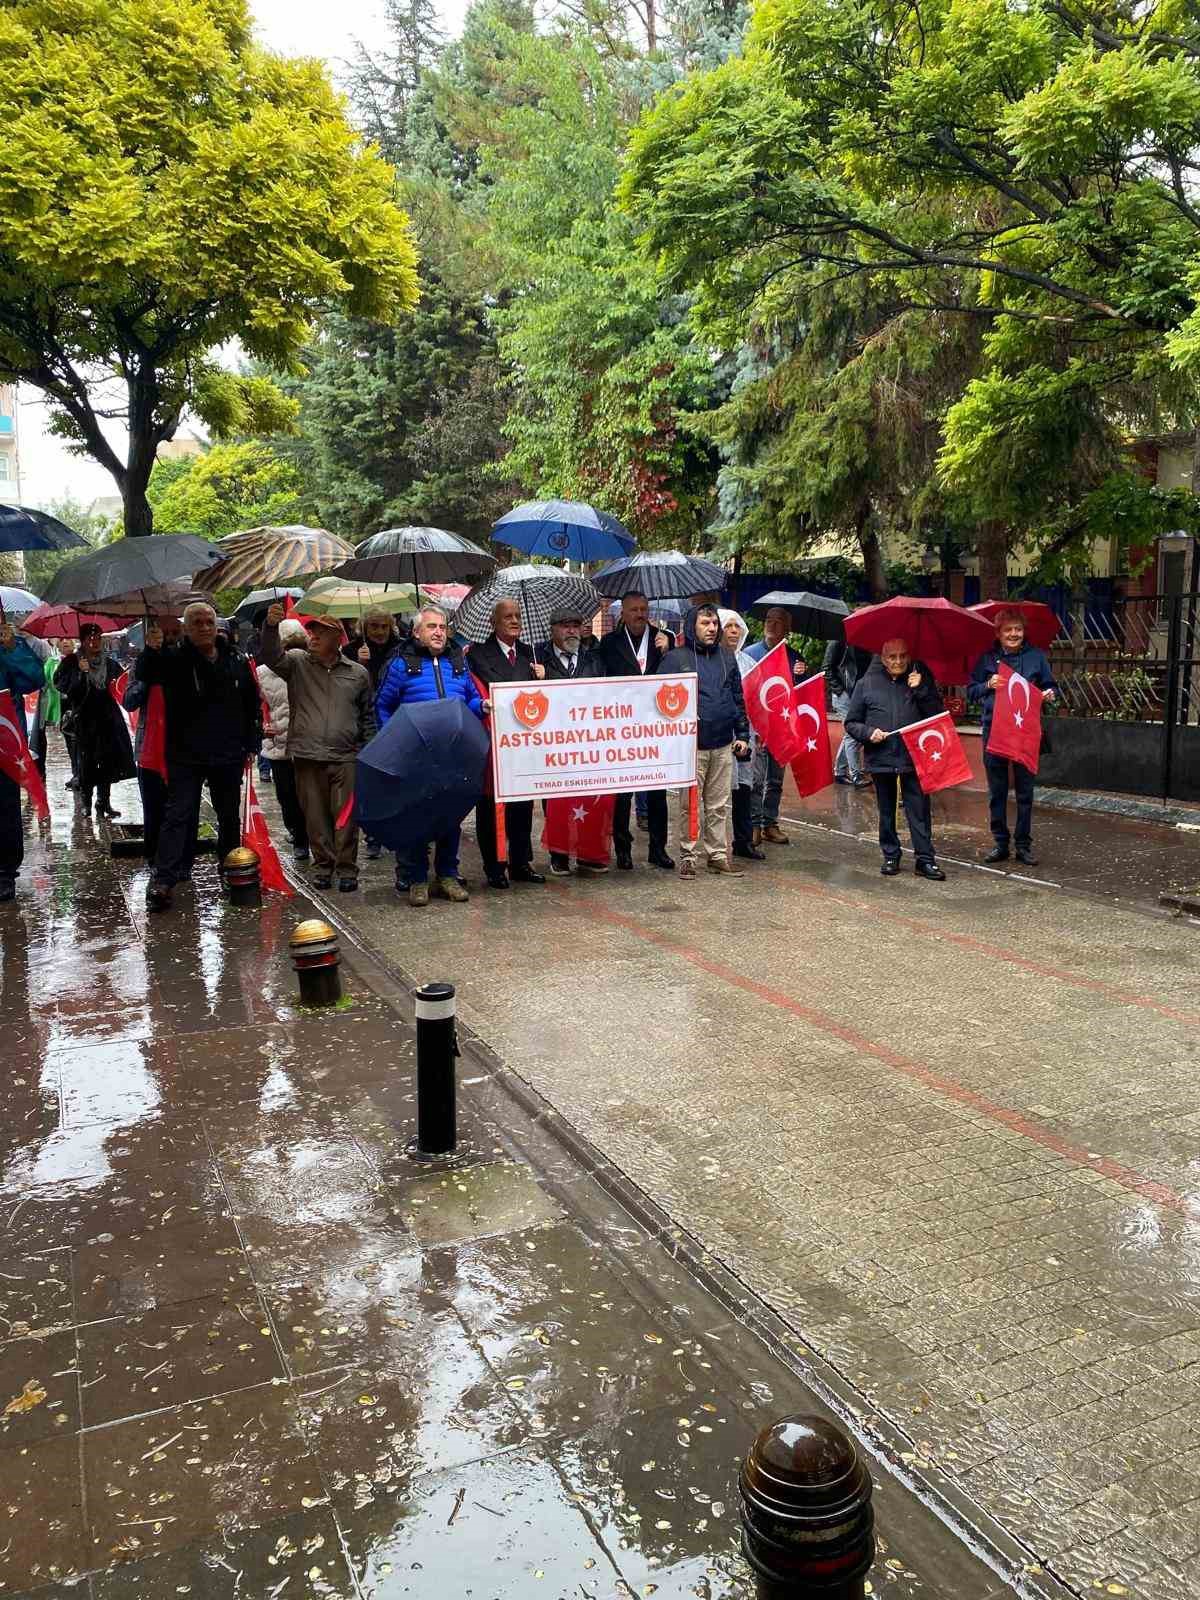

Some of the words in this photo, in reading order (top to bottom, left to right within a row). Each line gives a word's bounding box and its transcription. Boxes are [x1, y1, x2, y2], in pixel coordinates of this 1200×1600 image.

[569, 708, 587, 721] 17
[593, 702, 633, 720] EKİM
[500, 728, 617, 748] ASTSUBAYLAR
[621, 719, 697, 740] GÜNÜMÜZ
[545, 750, 600, 767] KUTLU
[606, 745, 660, 763] OLSUN
[534, 780, 562, 789] TEMAD
